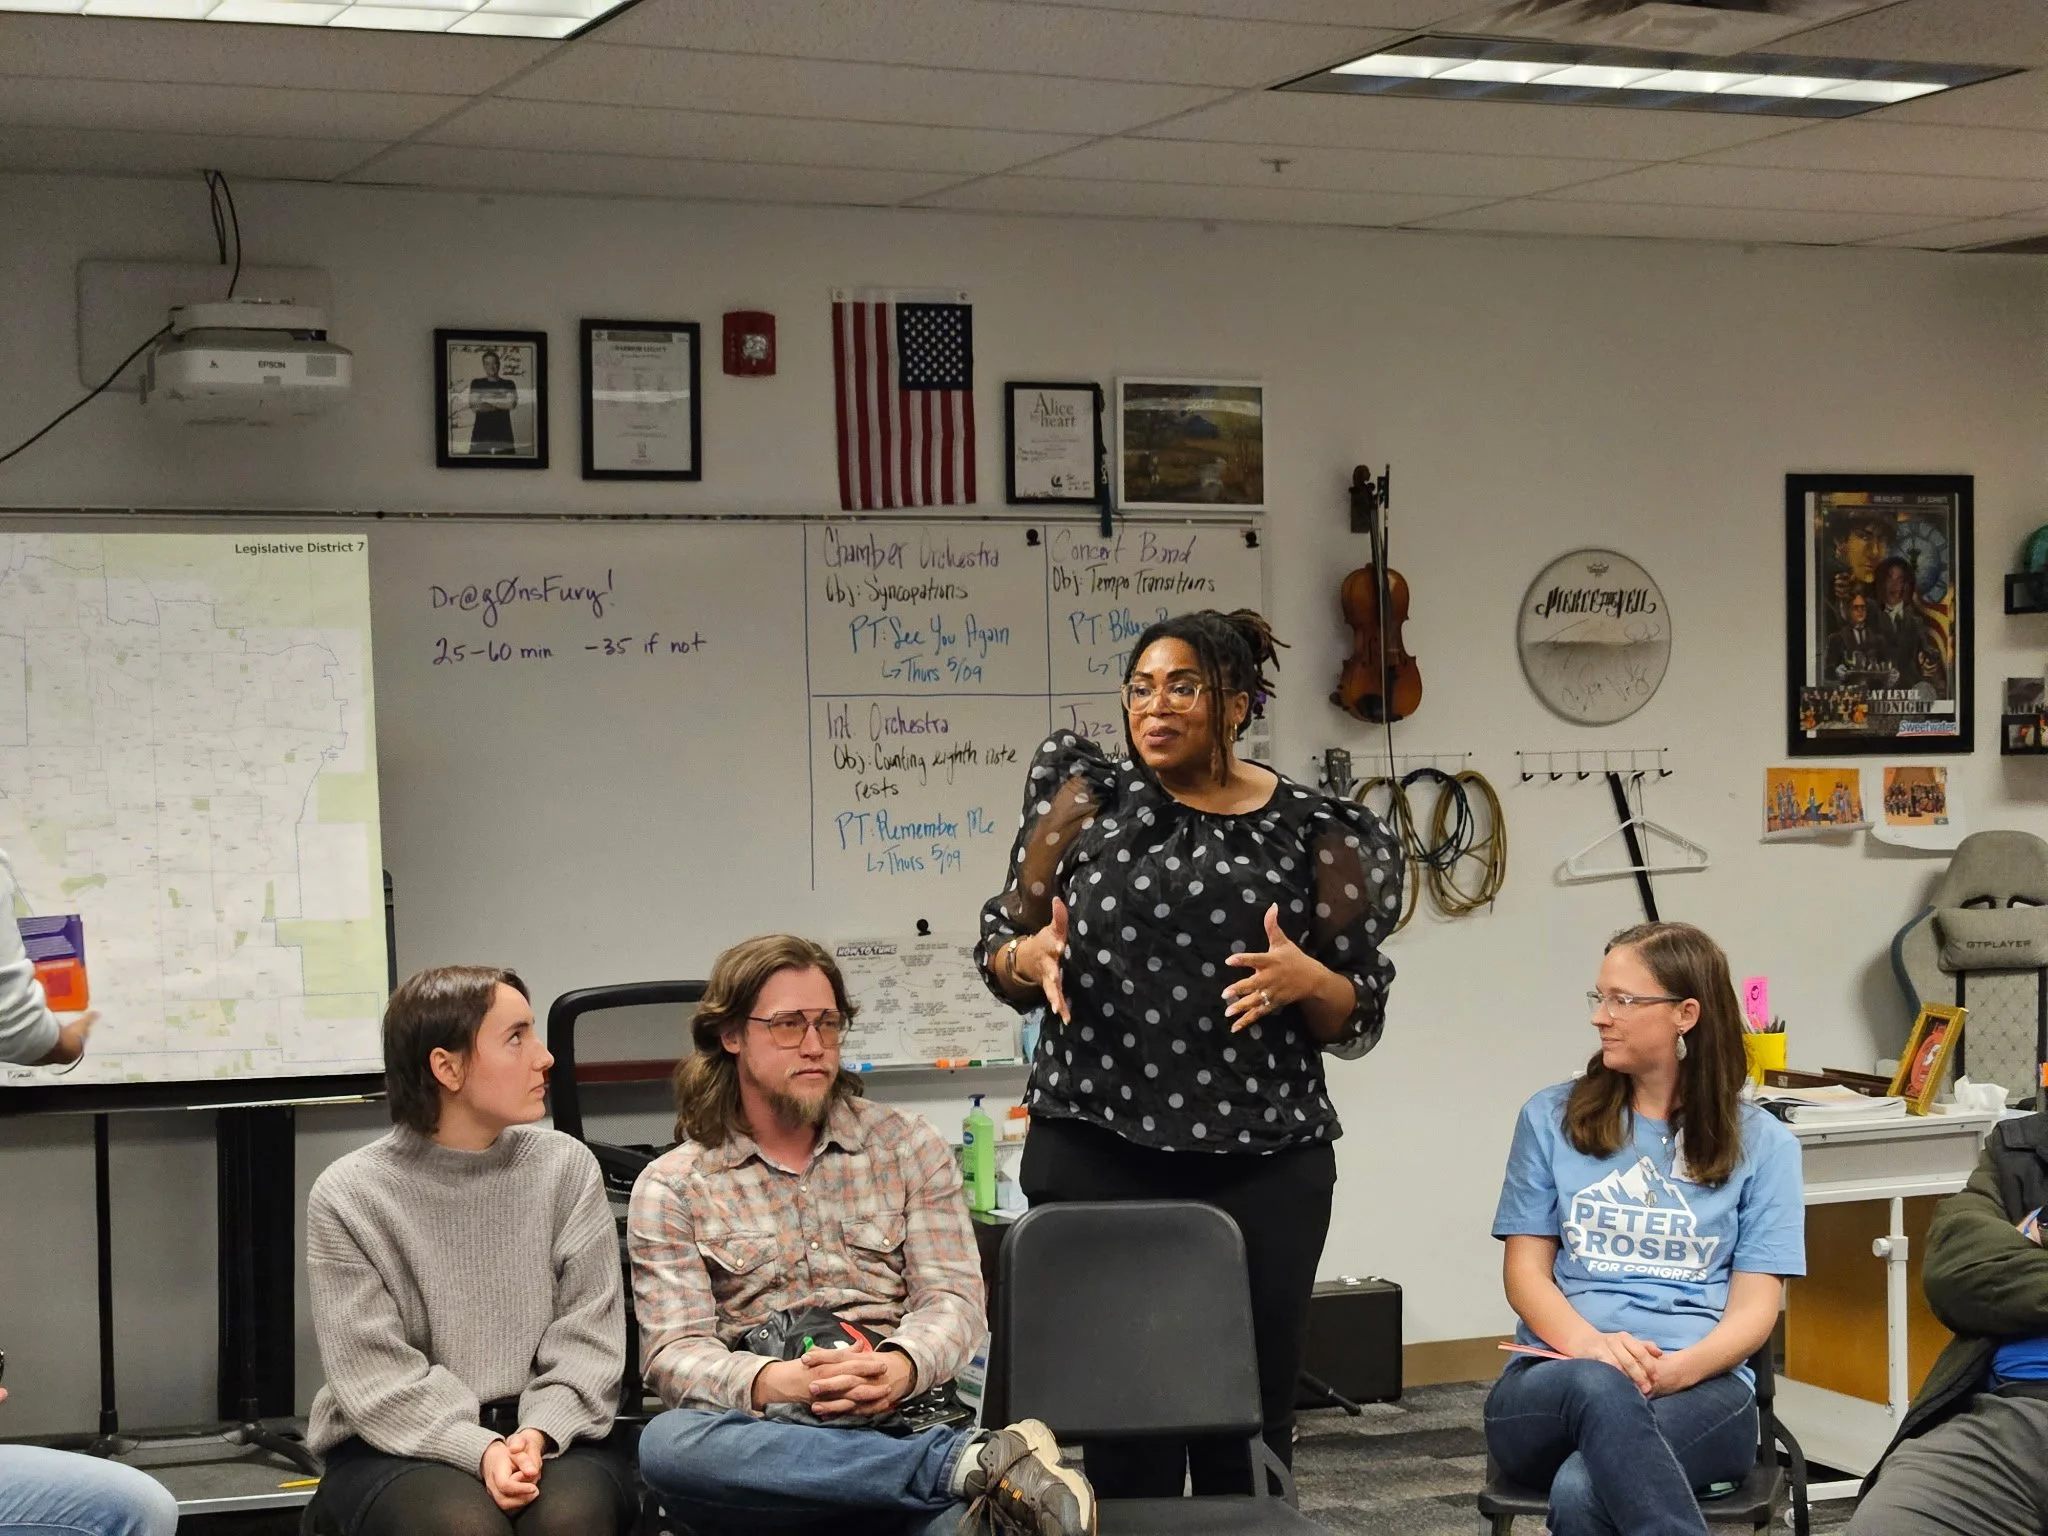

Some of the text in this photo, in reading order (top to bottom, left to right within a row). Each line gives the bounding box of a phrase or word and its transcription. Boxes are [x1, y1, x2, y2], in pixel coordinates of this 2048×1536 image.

[258, 360, 286, 369] EPSON
[1033, 392, 1074, 416] Alice
[1040, 409, 1077, 428] heart
[235, 541, 365, 556] Legislative District 7
[823, 526, 999, 571] Chamber Orchestra
[1051, 528, 1197, 564] Concert Band
[1085, 563, 1130, 600] Tempo
[520, 646, 553, 659] min
[644, 632, 660, 654] if
[670, 631, 707, 654] not
[889, 616, 926, 650] See
[930, 613, 956, 656] You
[965, 613, 1010, 659] Again
[900, 654, 983, 684] Thurs 5/09
[1886, 688, 1921, 700] LEVEL
[869, 702, 950, 742] Orchestra
[1060, 702, 1118, 739] Jazz
[1899, 720, 1956, 733] Sweetwater
[874, 742, 928, 786] Counting
[932, 740, 978, 785] eighth
[985, 744, 1018, 764] note
[854, 776, 900, 802] rests
[876, 808, 958, 842] Remember
[966, 806, 994, 838] Me
[883, 844, 924, 876] Thurs
[1966, 940, 2032, 949] GTPLAYER
[1574, 1202, 1692, 1237] PETER
[1565, 1226, 1712, 1264] CROSBY
[1587, 1260, 1619, 1272] FOR
